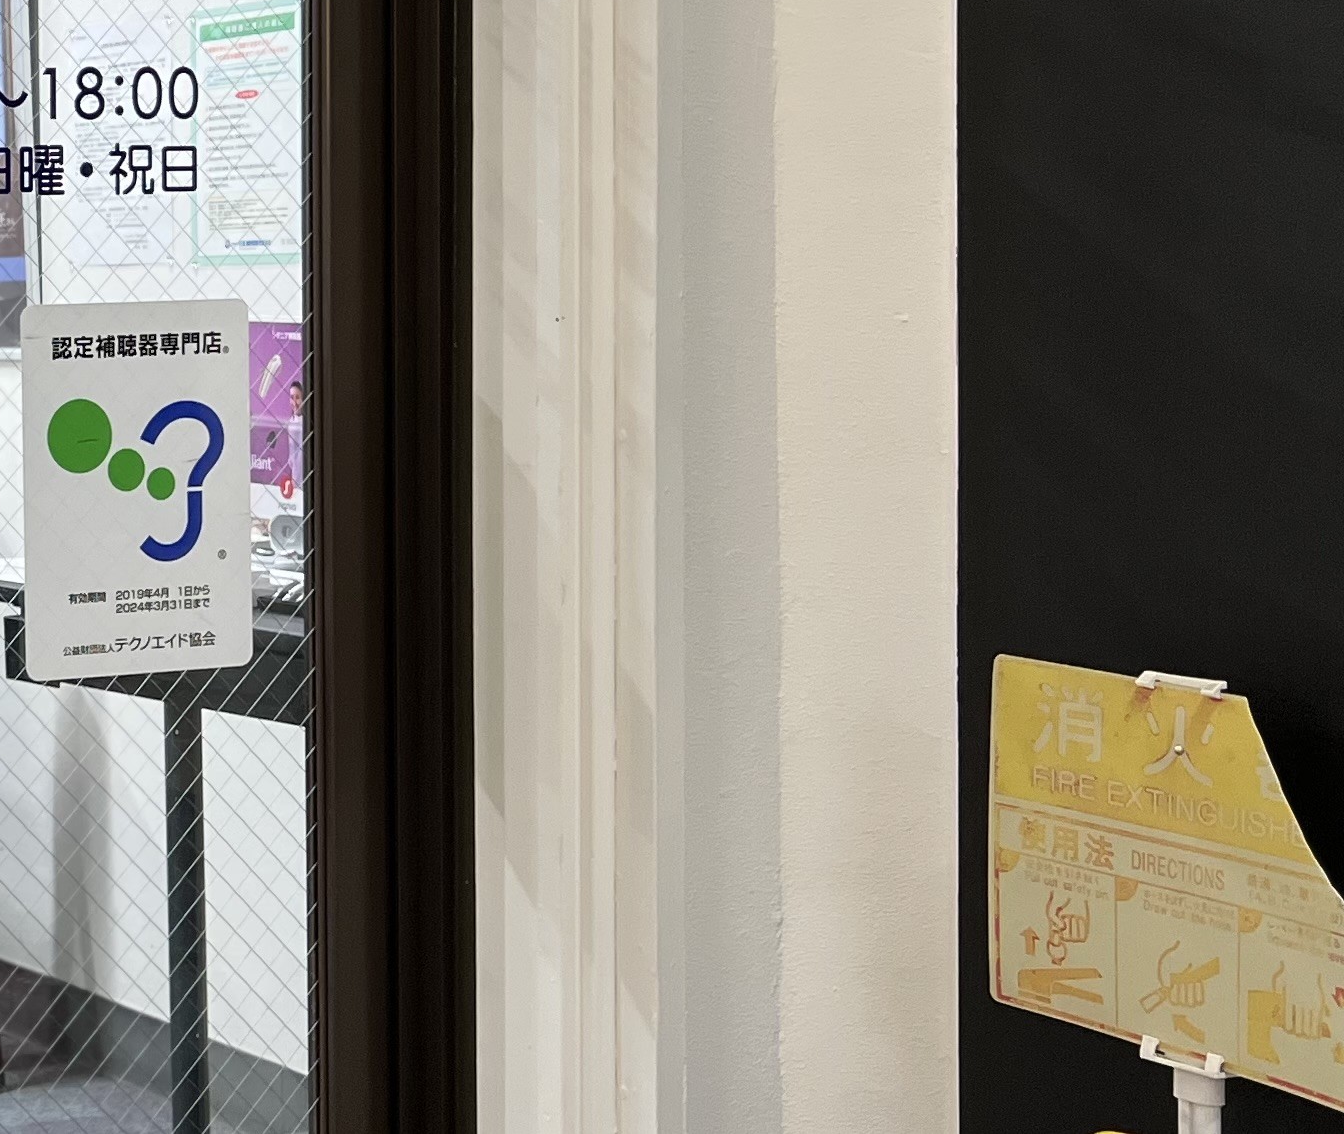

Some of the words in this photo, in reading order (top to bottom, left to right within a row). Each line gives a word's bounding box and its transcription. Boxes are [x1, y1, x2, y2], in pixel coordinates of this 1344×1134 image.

[51, 331, 223, 361] 認定補聴器専門店
[115, 586, 170, 601] 2019年4月
[115, 597, 211, 614] 2024年3月31日まで
[1030, 765, 1097, 802] FIRE
[1130, 849, 1225, 891] DIRECTIONS
